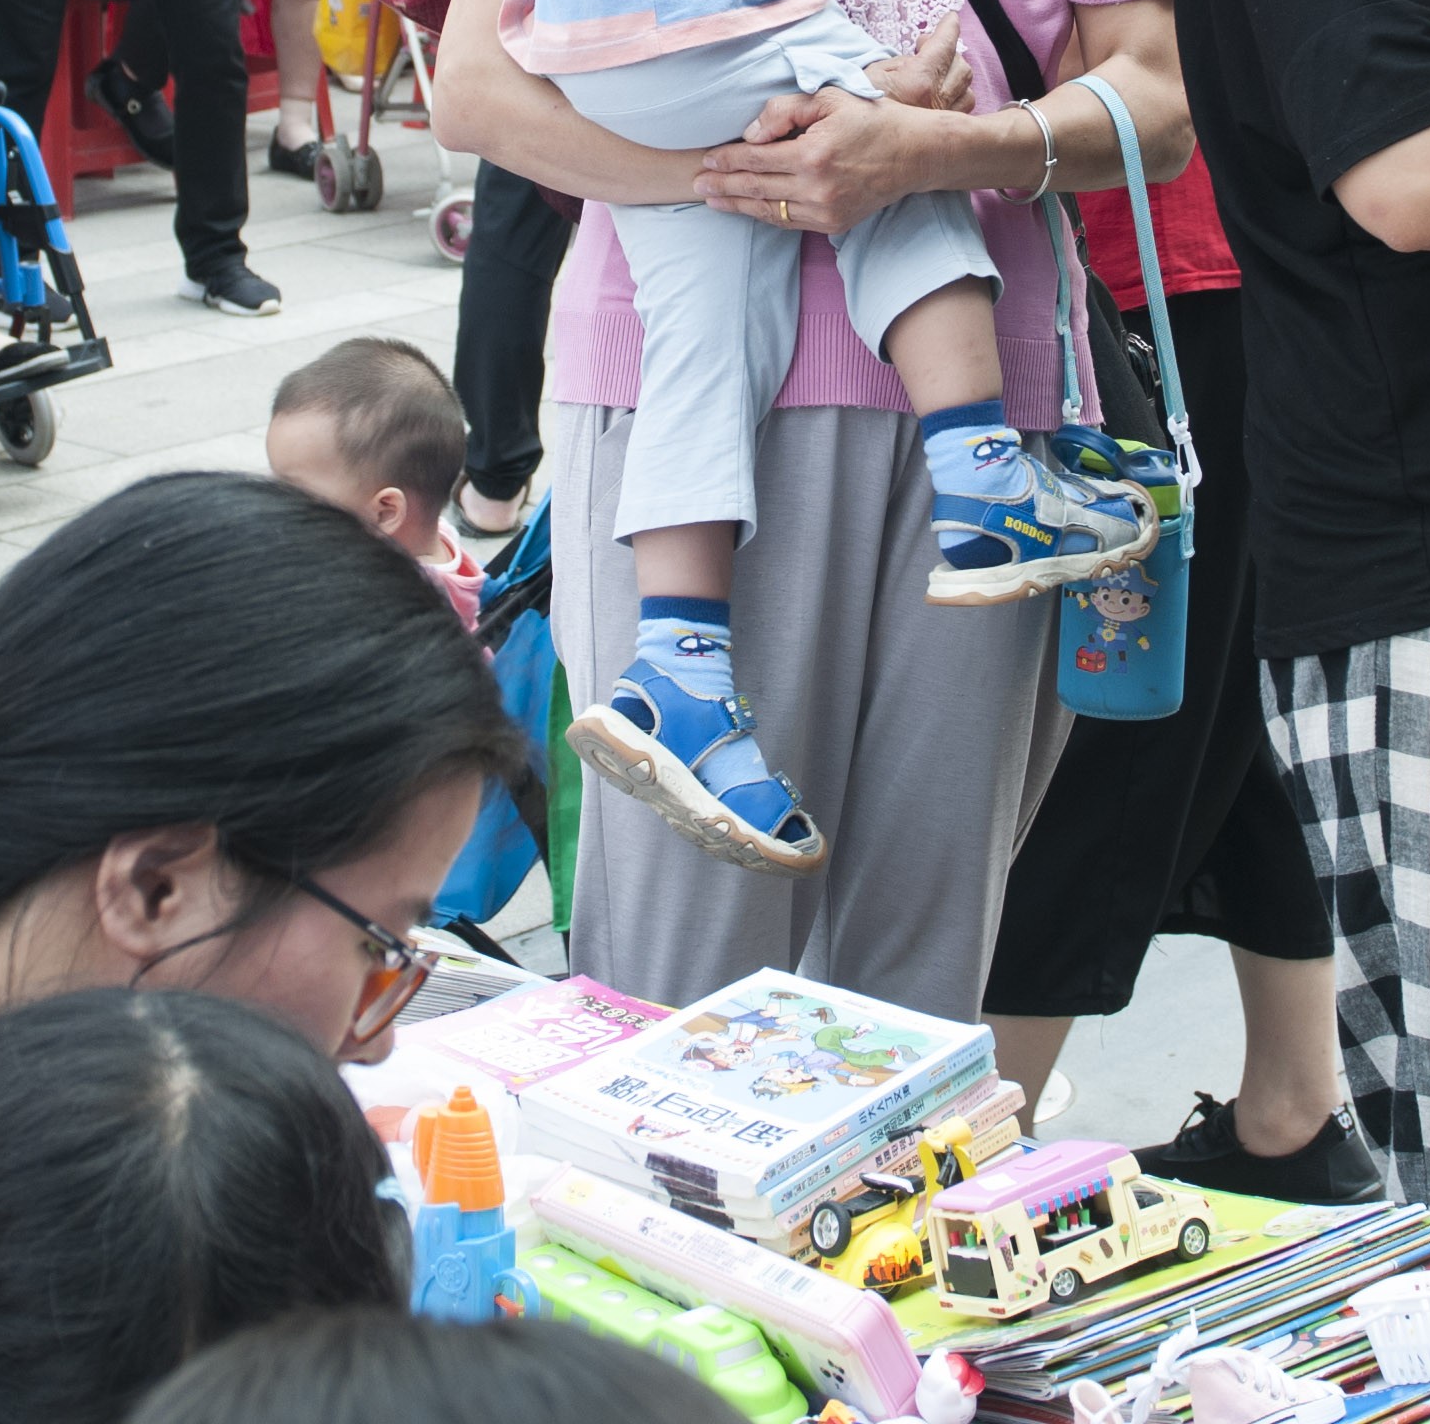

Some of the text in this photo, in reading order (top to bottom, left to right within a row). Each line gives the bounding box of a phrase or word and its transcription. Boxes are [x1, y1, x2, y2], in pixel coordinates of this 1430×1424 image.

[1004, 515, 1053, 546] BOBDOG
[595, 1066, 800, 1149] 淘气包马小跳
